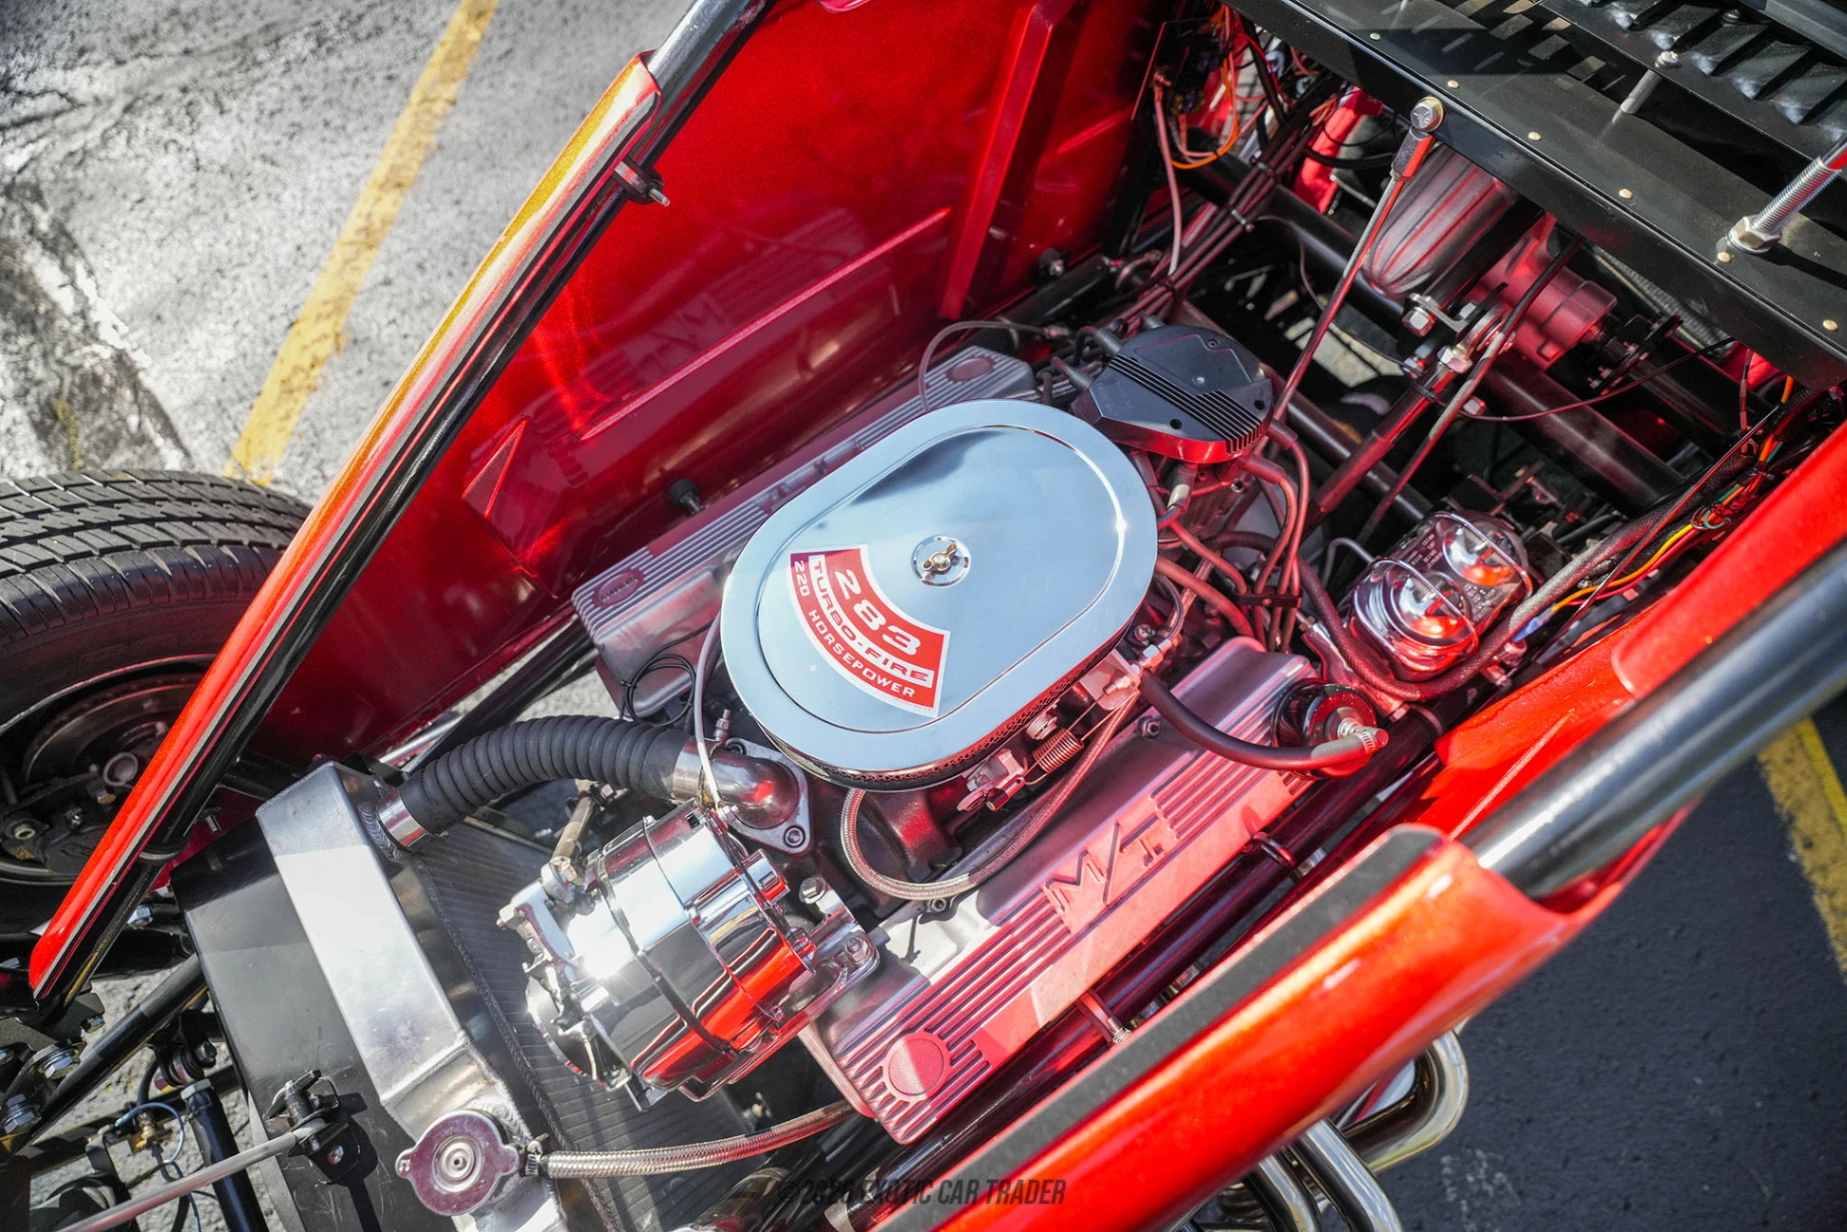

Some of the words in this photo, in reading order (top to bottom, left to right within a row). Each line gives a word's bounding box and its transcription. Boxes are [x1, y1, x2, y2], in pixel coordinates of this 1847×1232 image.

[794, 560, 810, 597] 220
[808, 609, 915, 698] HORSEPOWER
[813, 560, 929, 682] TURBO-FIRE
[835, 569, 921, 656] 283
